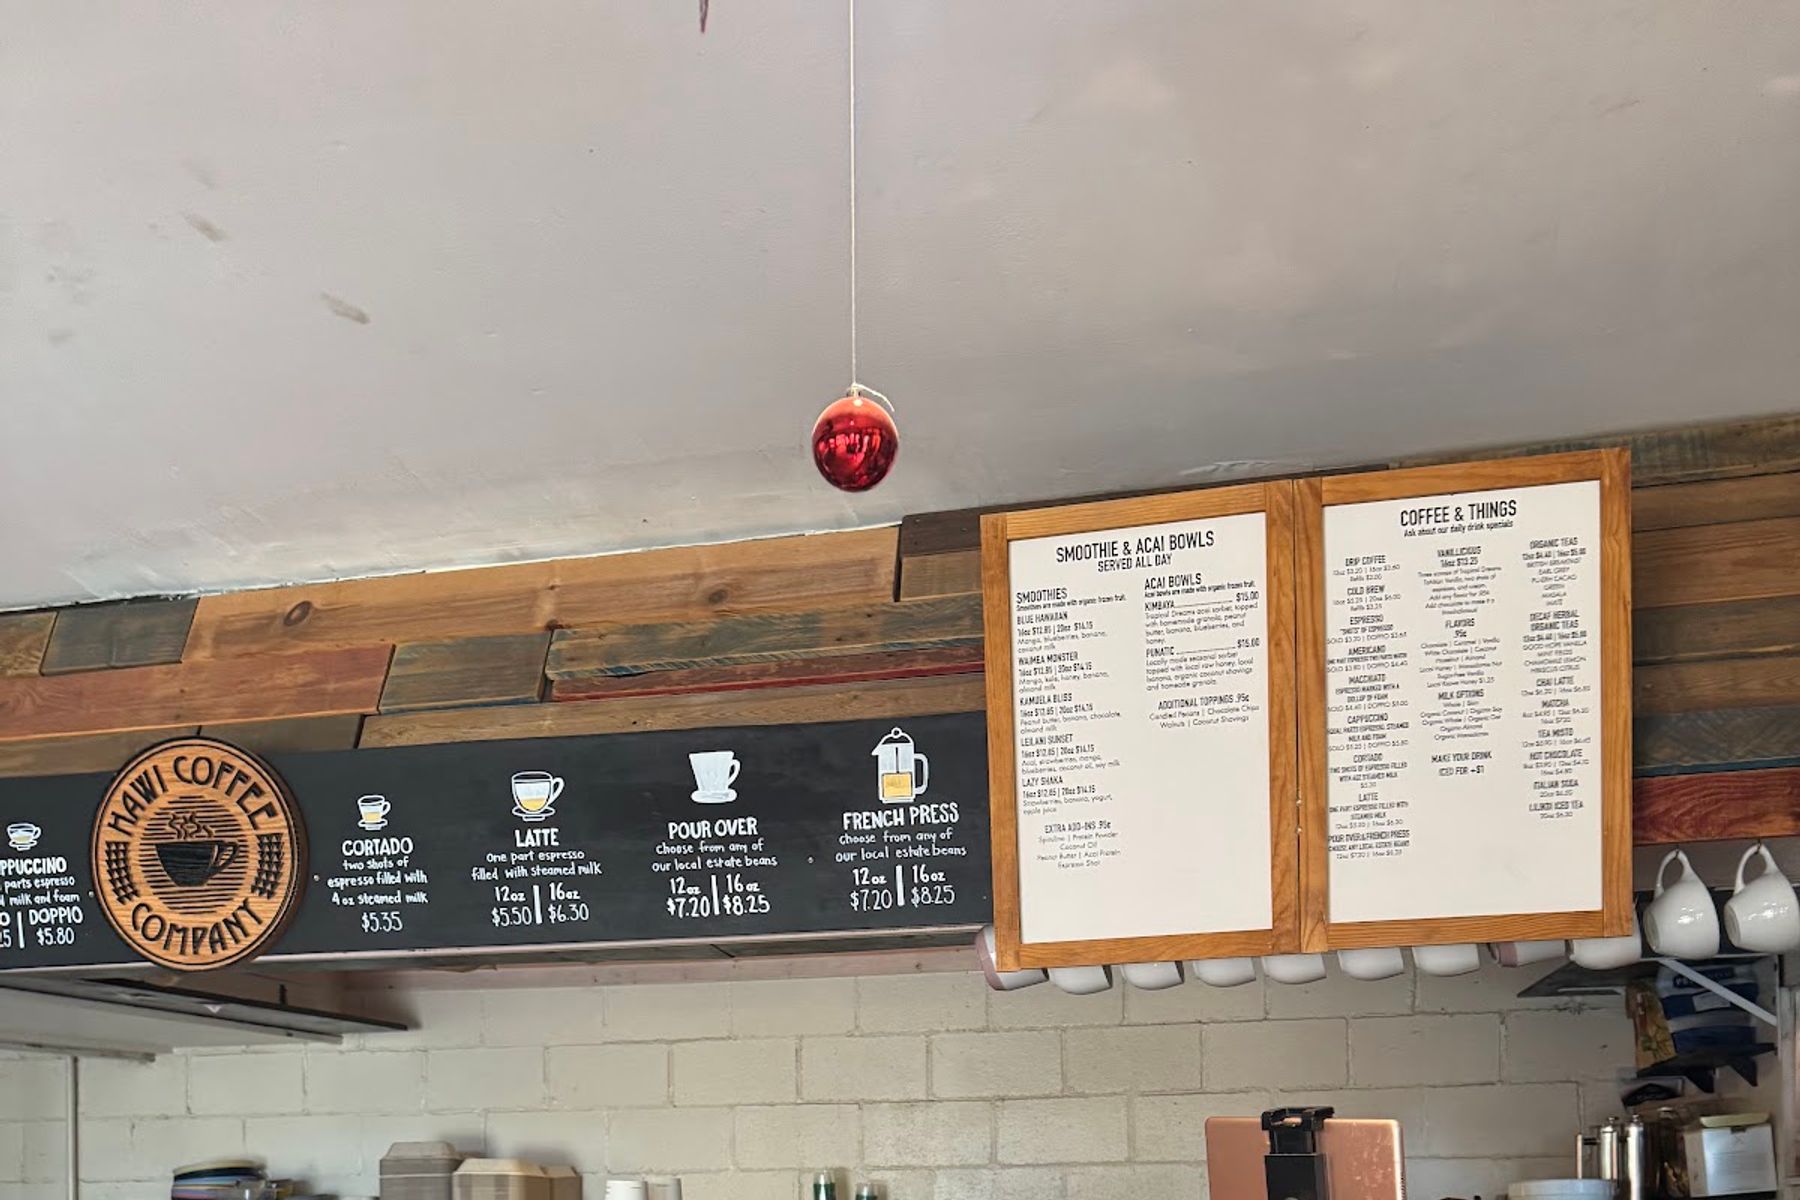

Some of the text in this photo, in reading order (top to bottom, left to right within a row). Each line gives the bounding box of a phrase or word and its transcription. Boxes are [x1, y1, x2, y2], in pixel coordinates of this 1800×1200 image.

[1400, 500, 1517, 526] COFFEE & THINGS
[1404, 528, 1416, 537] Ask
[1418, 527, 1436, 536] about
[1450, 523, 1466, 533] daily
[1467, 521, 1484, 530] drink
[1486, 520, 1513, 530] specials
[1056, 531, 1214, 562] SMOOTHIE & ACAI BOWLS
[1098, 552, 1173, 572] SERVED ALL DAY
[1144, 573, 1202, 590] ACAI BOWLS
[1016, 588, 1067, 604] SMOOTHIES
[1017, 614, 1033, 625] BLUE
[1047, 651, 1078, 663] MONSTER
[1053, 692, 1072, 702] BLISS
[1158, 698, 1198, 710] ADDITIONAL
[1048, 733, 1073, 744] SUNSET
[1022, 775, 1063, 787] LAZY SHAKA
[108, 756, 279, 837] HAWI COFFEE
[843, 802, 960, 830] FRENCH PRESS
[515, 828, 560, 848] LATTE
[668, 817, 758, 840] POUR OVER
[839, 827, 953, 845] choose from any of
[1044, 824, 1066, 833] EXTRA
[342, 837, 414, 856] CORTADO
[656, 838, 764, 855] choose from any of
[836, 844, 967, 863] our local estate beans
[342, 856, 409, 871] two shots of
[511, 850, 534, 865] part
[538, 850, 585, 863] espresso
[652, 855, 778, 873] our local estate beans
[327, 869, 428, 890] espresso filled with
[471, 862, 602, 881] filled with steamed milk
[853, 864, 946, 886] 12oz 16oz
[4, 876, 75, 895] parts espresso
[495, 885, 526, 902] 12oz
[670, 876, 701, 894] 12oz
[9, 888, 80, 906] milk and foam
[358, 890, 401, 905] steamed
[405, 892, 428, 904] milk
[666, 894, 771, 919] $7.20 $8.25
[850, 885, 955, 911] $7.20 $8.25
[28, 905, 84, 925] DOPPIO
[361, 911, 403, 933] $5.35
[491, 903, 589, 927] $5.50 $6.30
[36, 926, 75, 946] $5.80
[131, 897, 263, 956] COMPANY
